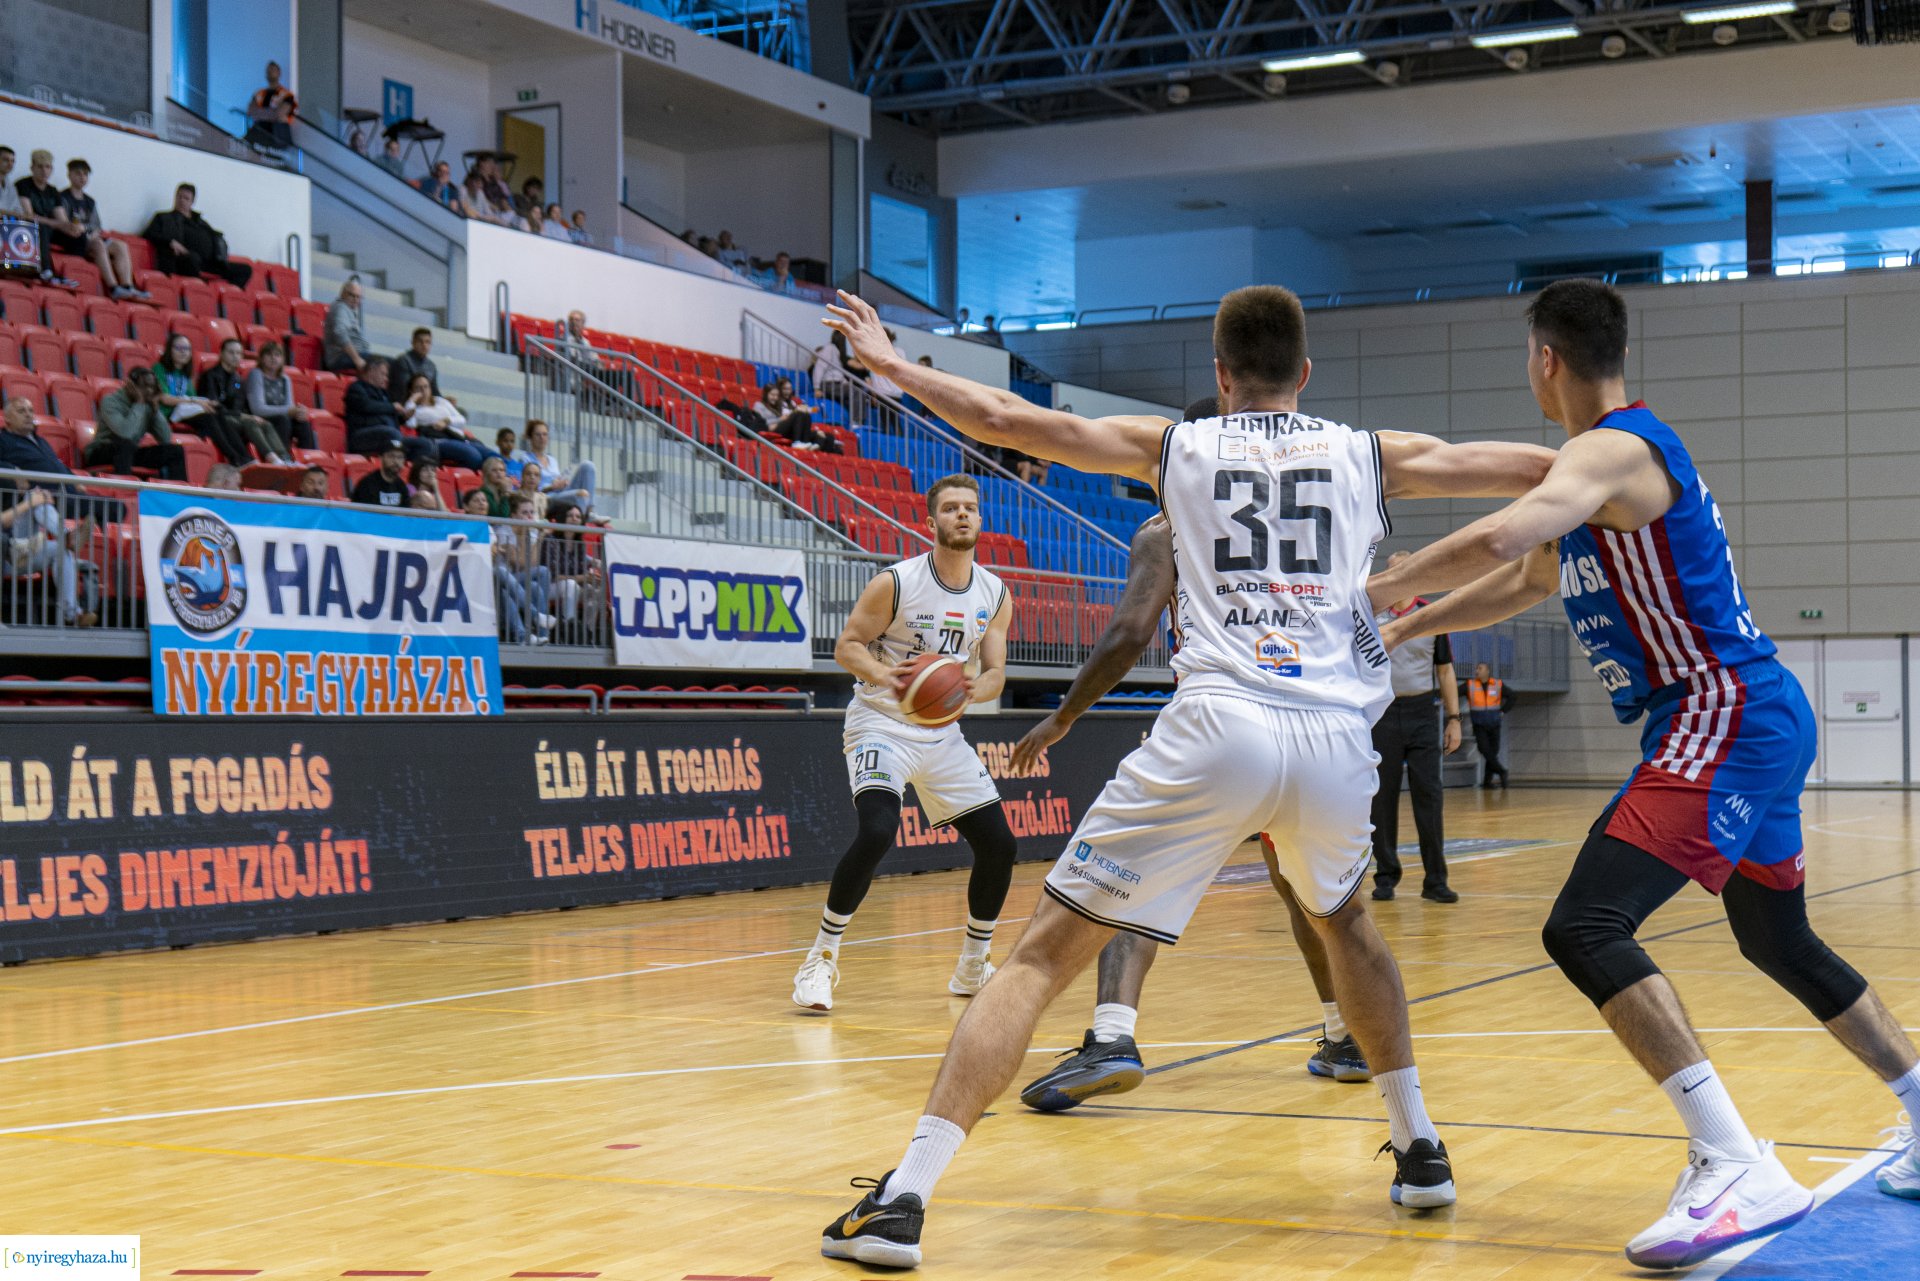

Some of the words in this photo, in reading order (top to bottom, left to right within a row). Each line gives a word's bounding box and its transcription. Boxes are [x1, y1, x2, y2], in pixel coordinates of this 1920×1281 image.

[601, 14, 677, 62] HÜBNER
[1213, 468, 1332, 575] 35
[262, 533, 473, 624] HAJRÁ
[1216, 582, 1325, 596] BLADESPORT
[937, 628, 965, 655] 20
[1576, 614, 1614, 634] MVM
[160, 629, 491, 715] NYÍREGYHÁZA!
[67, 745, 118, 819] ÁT
[132, 759, 162, 816] A
[170, 743, 332, 815] FOGADÁS
[535, 740, 588, 799] ÉLD
[596, 740, 626, 797] ÁT
[636, 750, 655, 795] A
[657, 738, 762, 794] FOGADÁS
[854, 749, 880, 778] 20
[524, 823, 627, 877] TELJES
[630, 805, 791, 870] DIMENZIÓJÁT!
[119, 829, 371, 912] DIMENZIÓJÁT!
[1082, 871, 1117, 895] SUNSHINE
[1114, 889, 1131, 901] FM
[1091, 853, 1142, 885] HÜBNER
